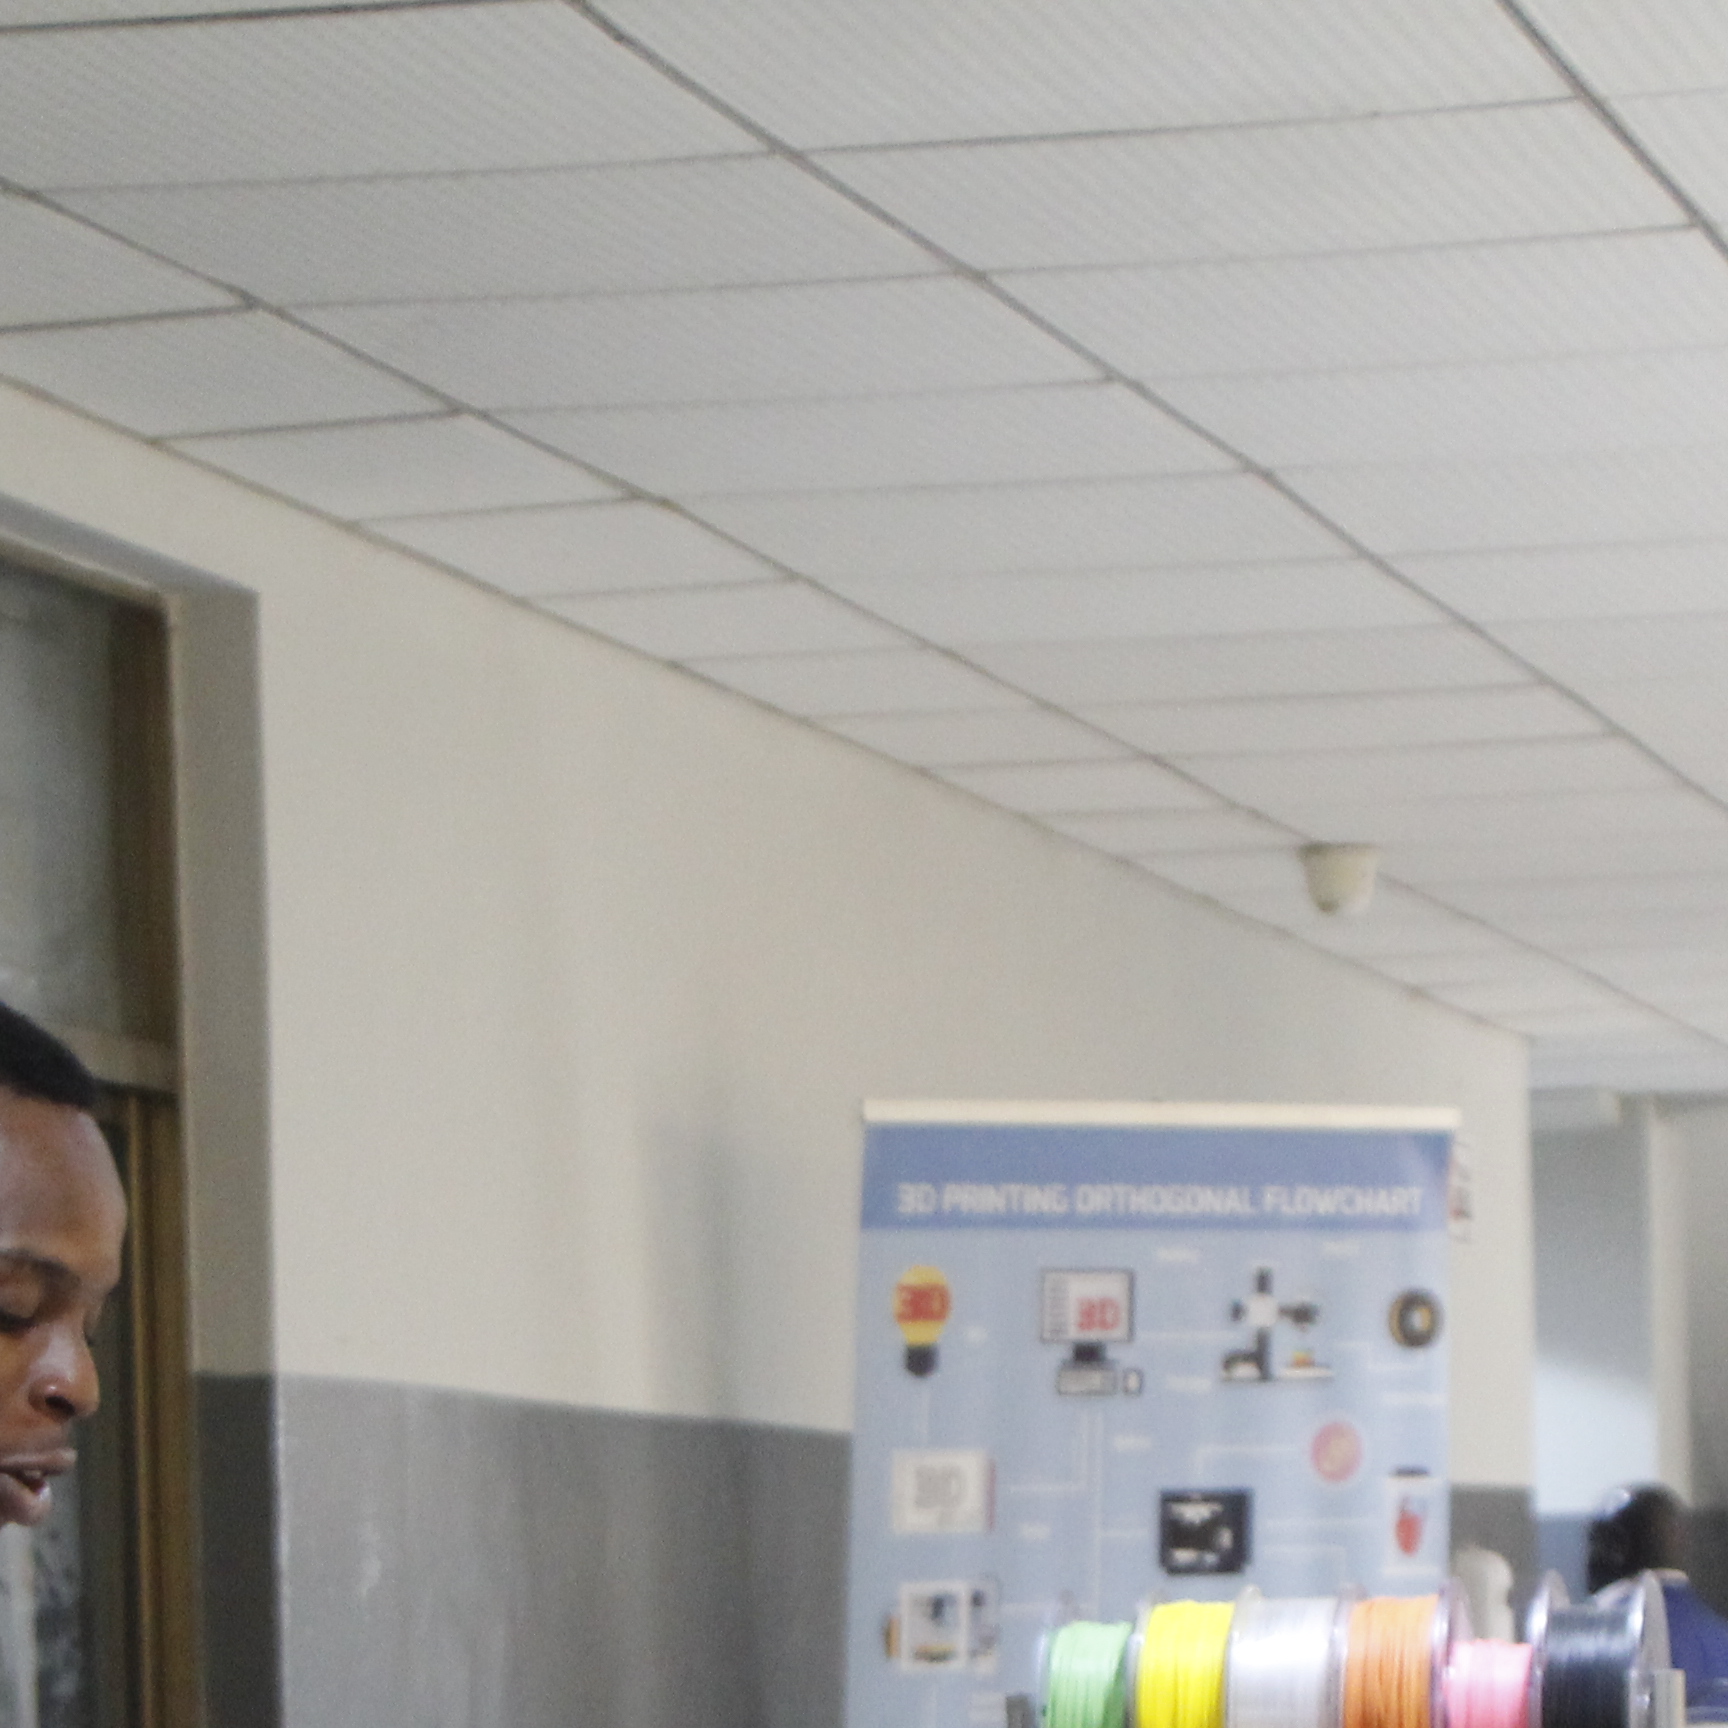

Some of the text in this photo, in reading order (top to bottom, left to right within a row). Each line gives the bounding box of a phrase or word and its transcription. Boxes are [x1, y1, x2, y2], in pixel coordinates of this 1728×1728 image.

[897, 1182, 1422, 1216] 3D PRINTING ORTHOGONAL FLOWCHART
[1078, 1298, 1119, 1331] 3D
